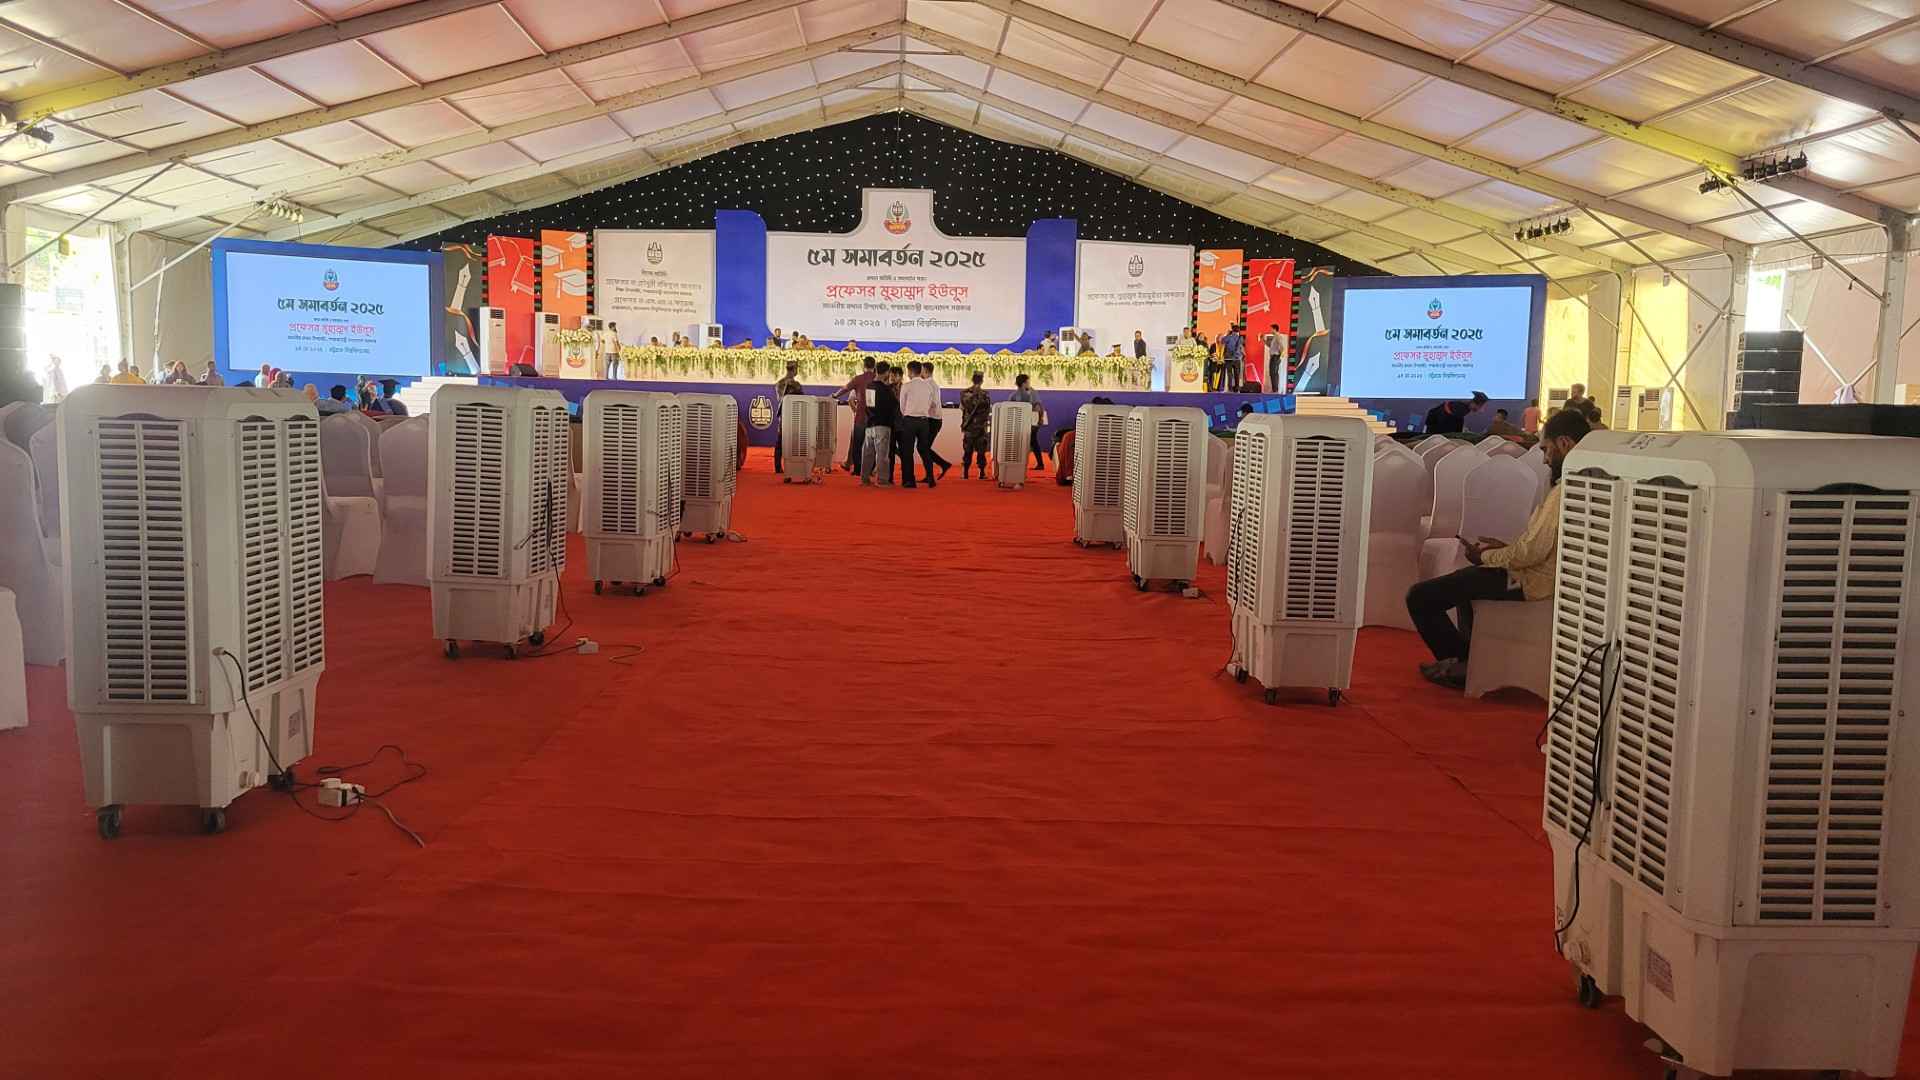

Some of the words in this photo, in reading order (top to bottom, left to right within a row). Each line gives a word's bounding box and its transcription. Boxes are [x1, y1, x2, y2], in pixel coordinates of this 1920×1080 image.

[807, 248, 835, 267] ৫ম
[842, 243, 924, 267] সমাবর্তন
[929, 250, 986, 268] ২০২৫
[826, 285, 876, 298] প্রফেসর
[880, 285, 925, 301] মুহাম্মদ
[928, 283, 969, 303] ইউনূস
[277, 298, 295, 311] ৫ম
[298, 296, 348, 313] সমাবর্তন
[350, 302, 385, 315] ২০২৫
[1385, 328, 1401, 341] ৫ম
[1403, 324, 1449, 341] সমাবর্তন
[1451, 328, 1483, 341] ২০২৫
